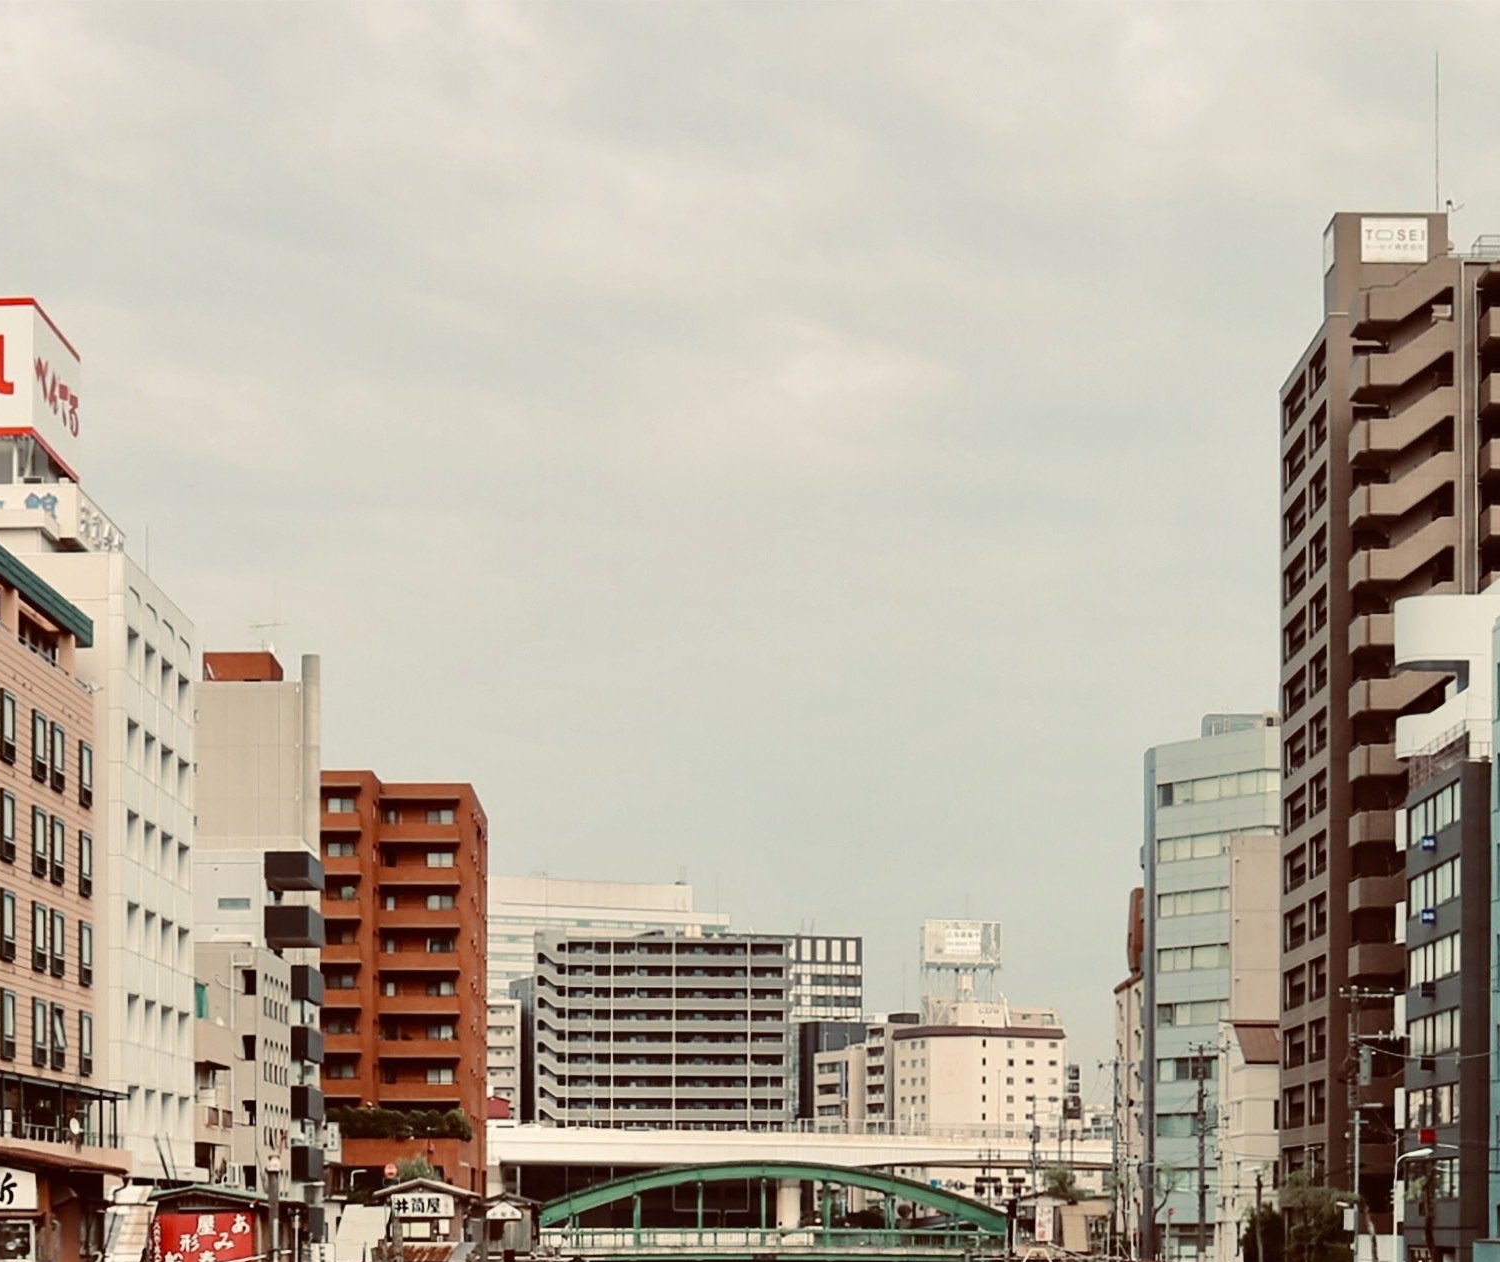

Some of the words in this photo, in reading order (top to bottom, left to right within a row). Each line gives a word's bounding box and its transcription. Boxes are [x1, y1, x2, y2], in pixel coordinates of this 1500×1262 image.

[1365, 229, 1425, 241] TOSEI
[395, 1197, 441, 1214] 井筒屋
